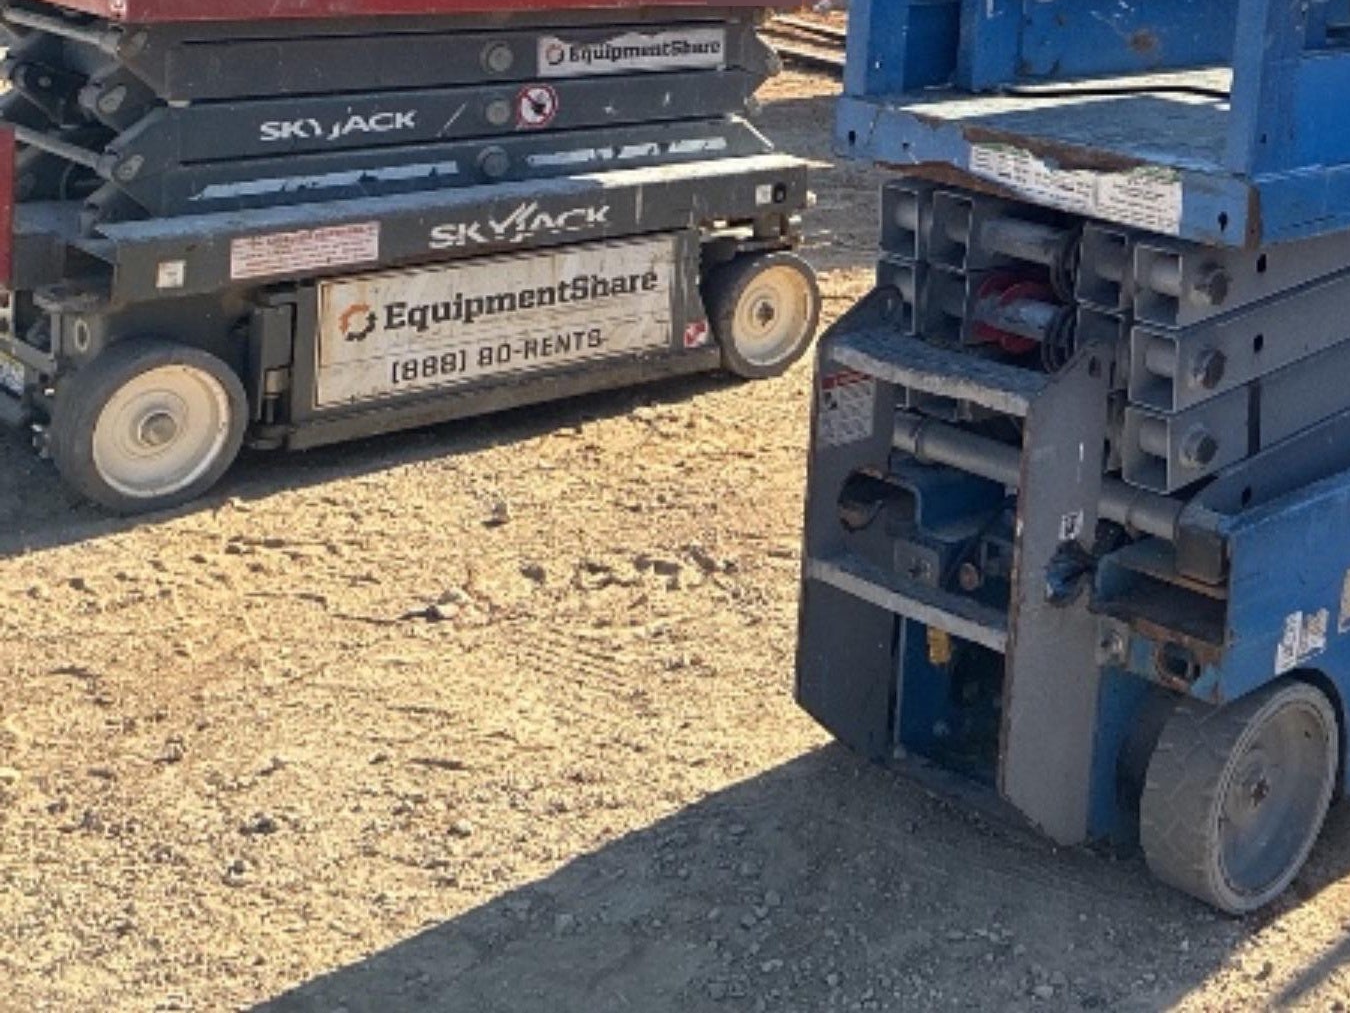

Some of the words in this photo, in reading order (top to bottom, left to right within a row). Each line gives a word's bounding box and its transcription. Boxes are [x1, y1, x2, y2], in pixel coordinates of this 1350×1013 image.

[569, 40, 721, 64] EquipmentShare
[429, 200, 610, 249] SKYJACK
[383, 270, 658, 333] EquipmentShare
[476, 329, 605, 368] 80-RENTS
